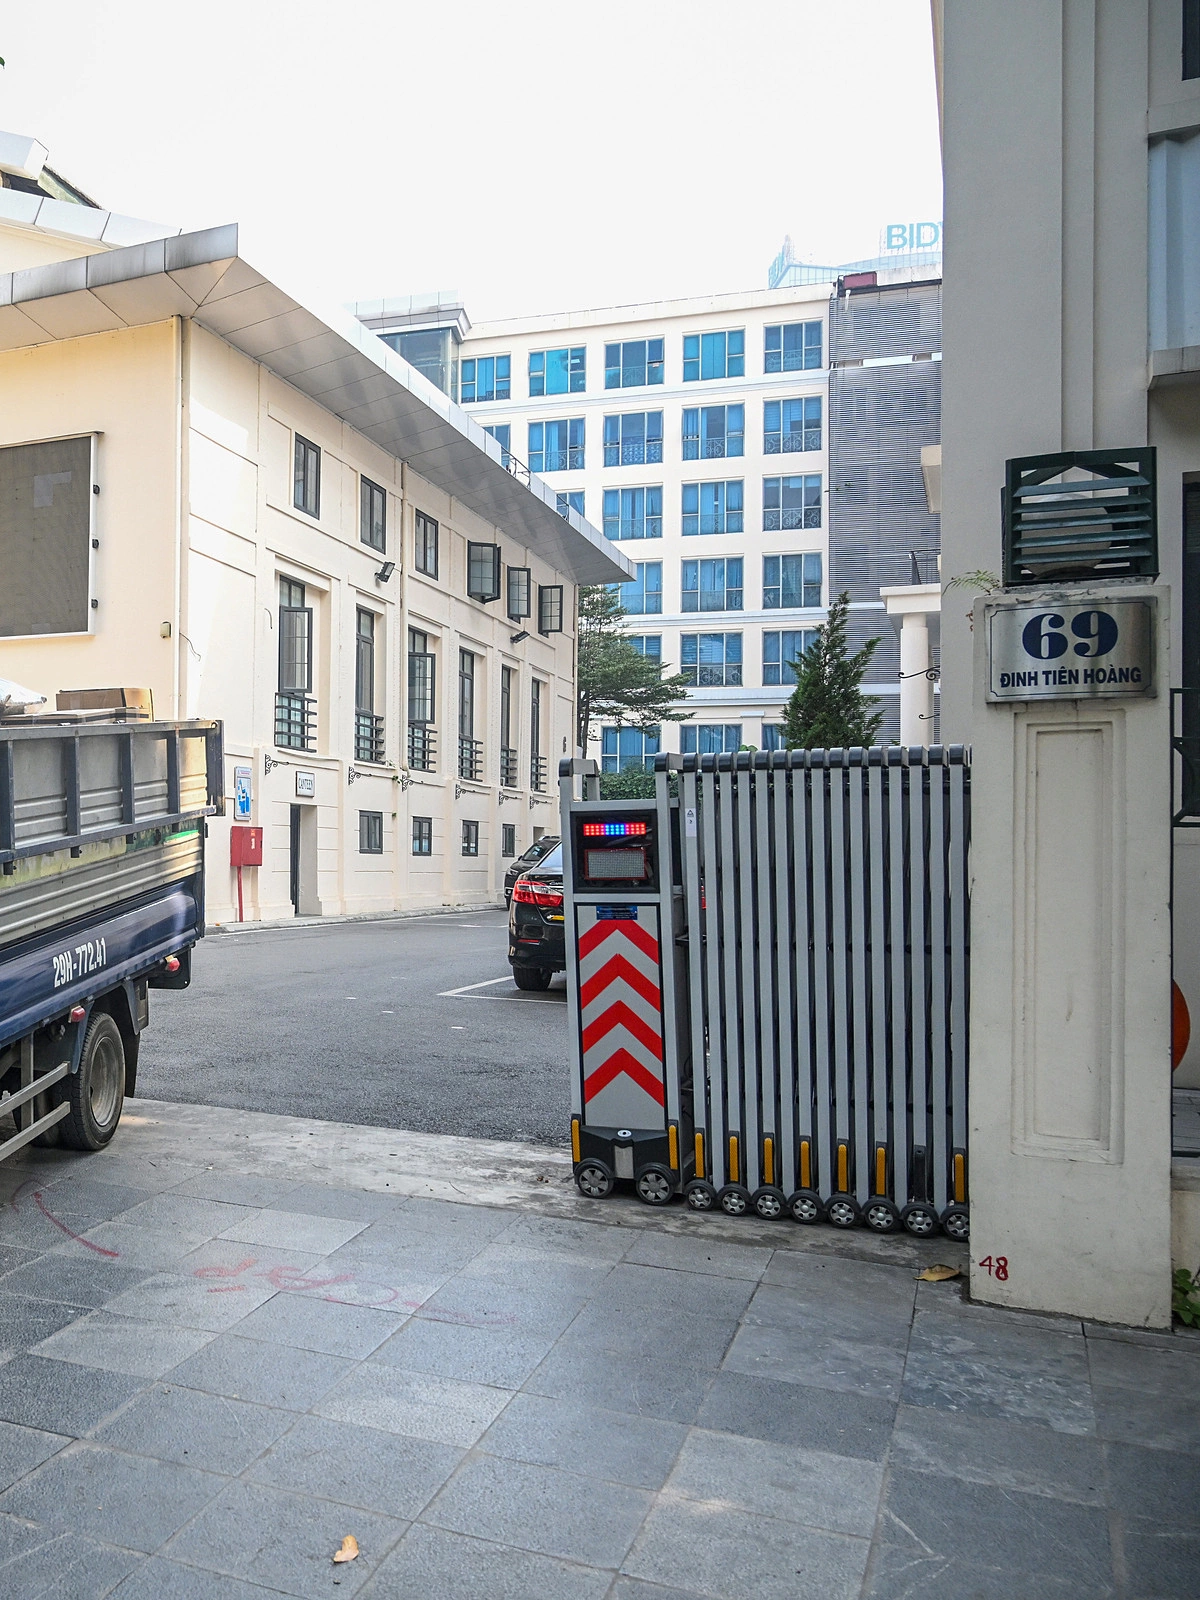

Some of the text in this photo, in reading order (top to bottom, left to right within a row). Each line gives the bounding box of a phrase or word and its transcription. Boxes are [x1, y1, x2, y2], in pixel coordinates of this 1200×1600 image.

[887, 221, 942, 250] BID
[1022, 610, 1119, 660] 69
[1000, 664, 1142, 688] ĐINH TIÊN HOÀNG
[298, 777, 313, 790] CANTEEN
[52, 937, 106, 988] 29H-772.41
[979, 1255, 1009, 1281] 48
